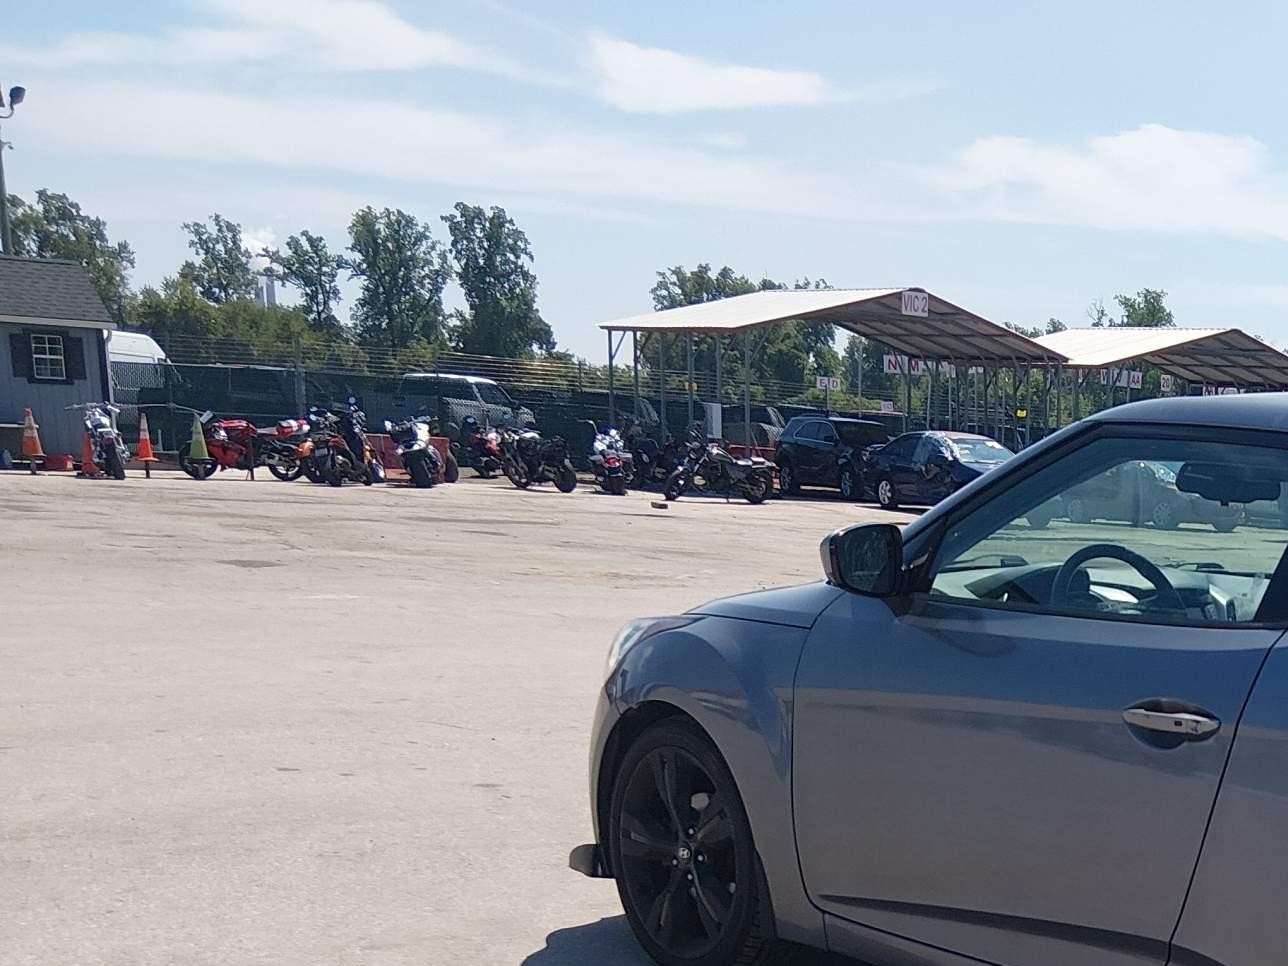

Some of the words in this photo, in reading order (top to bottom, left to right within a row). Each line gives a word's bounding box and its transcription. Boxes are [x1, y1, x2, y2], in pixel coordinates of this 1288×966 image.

[903, 294, 920, 313] VIC
[921, 296, 928, 313] 2
[887, 359, 897, 371] N
